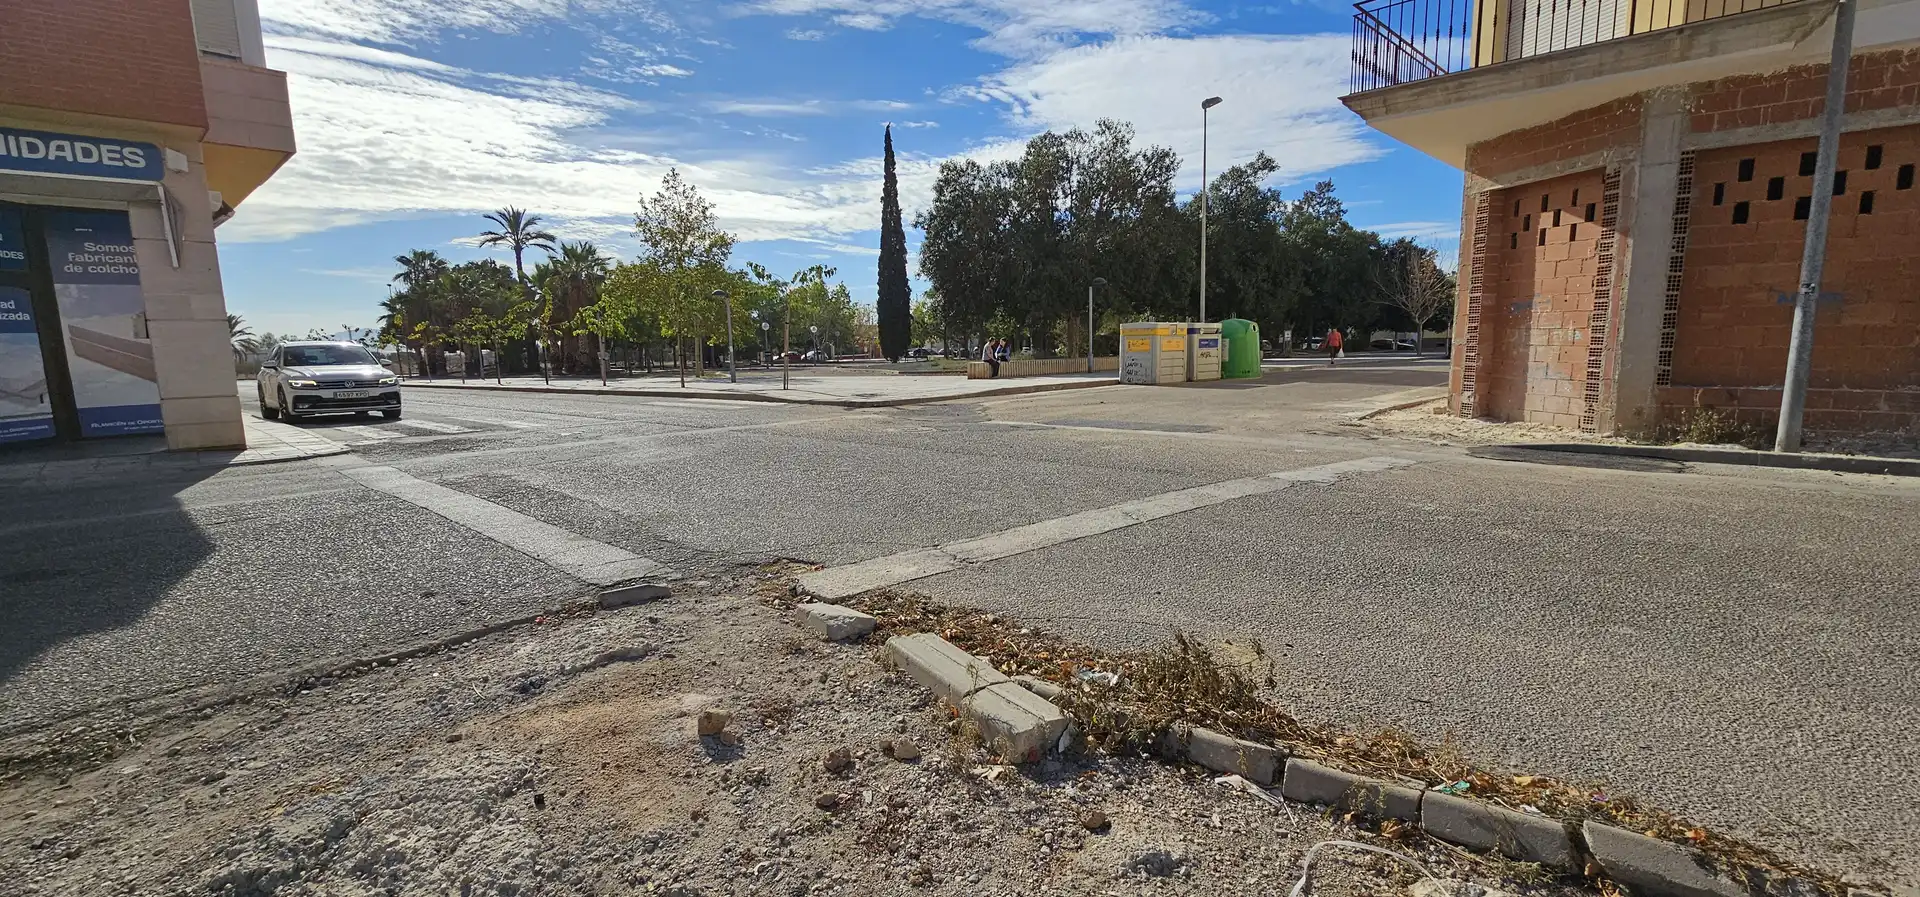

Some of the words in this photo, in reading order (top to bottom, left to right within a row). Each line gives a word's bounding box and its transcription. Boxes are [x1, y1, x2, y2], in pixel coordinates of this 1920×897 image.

[83, 242, 136, 253] Somos
[63, 264, 83, 273] de
[88, 264, 138, 274] colcho
